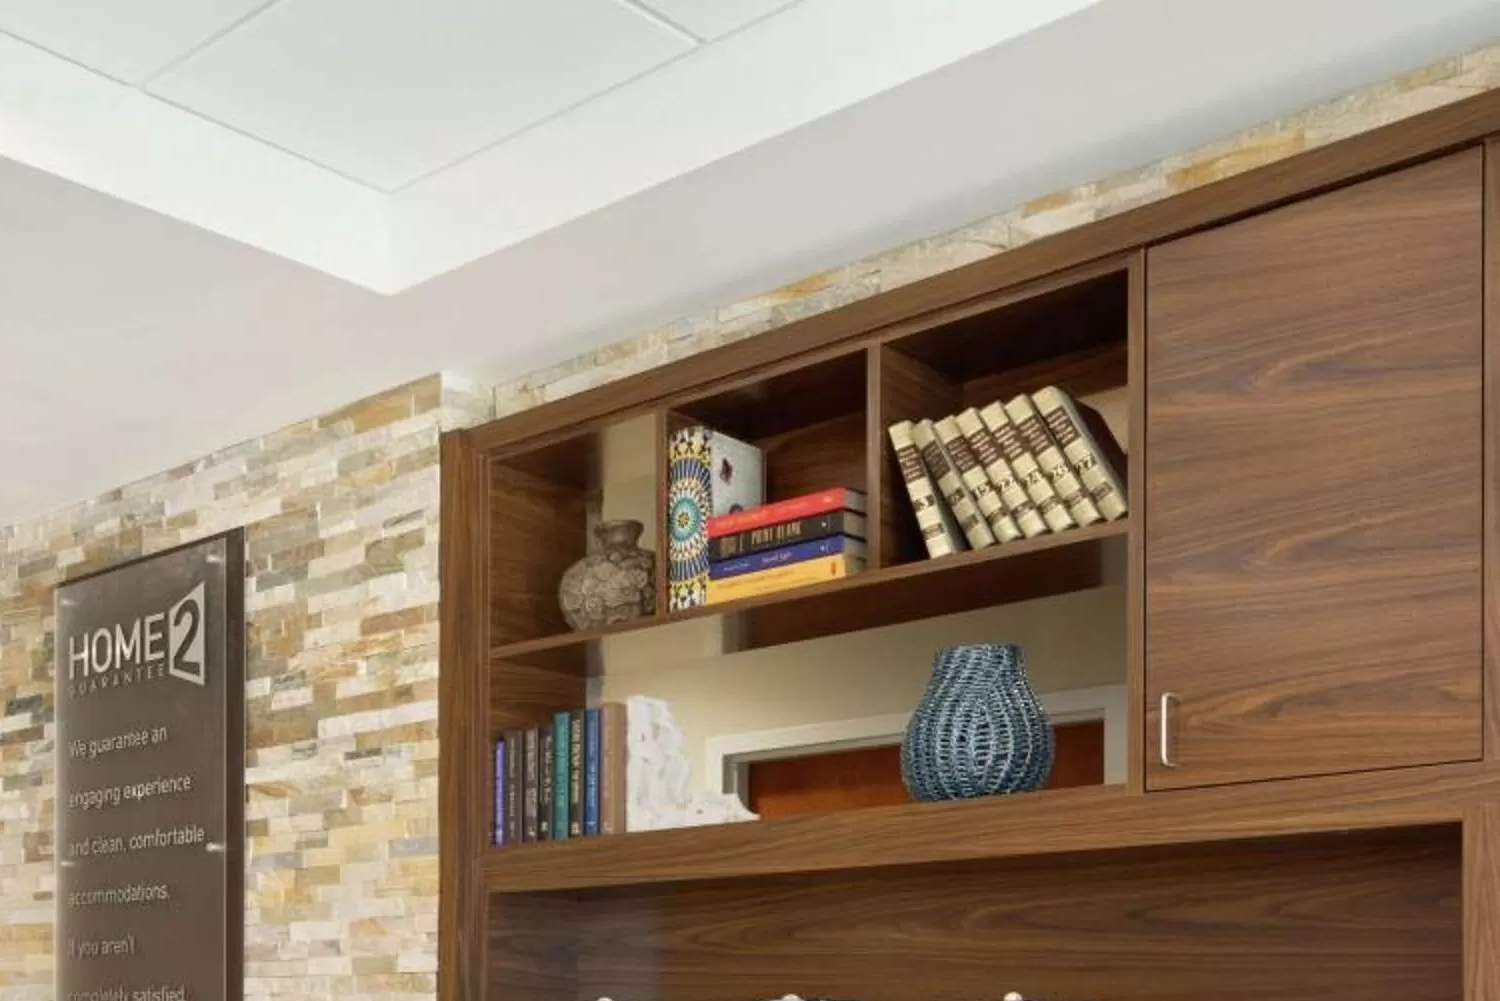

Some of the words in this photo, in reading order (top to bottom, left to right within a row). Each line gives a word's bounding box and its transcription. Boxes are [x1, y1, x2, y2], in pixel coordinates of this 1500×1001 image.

[68, 739, 87, 757] We
[89, 729, 148, 759] guarantee
[151, 727, 168, 743] an
[69, 787, 121, 810] engaging
[123, 776, 192, 800] experience
[129, 824, 205, 850] comfortable
[78, 940, 99, 960] you
